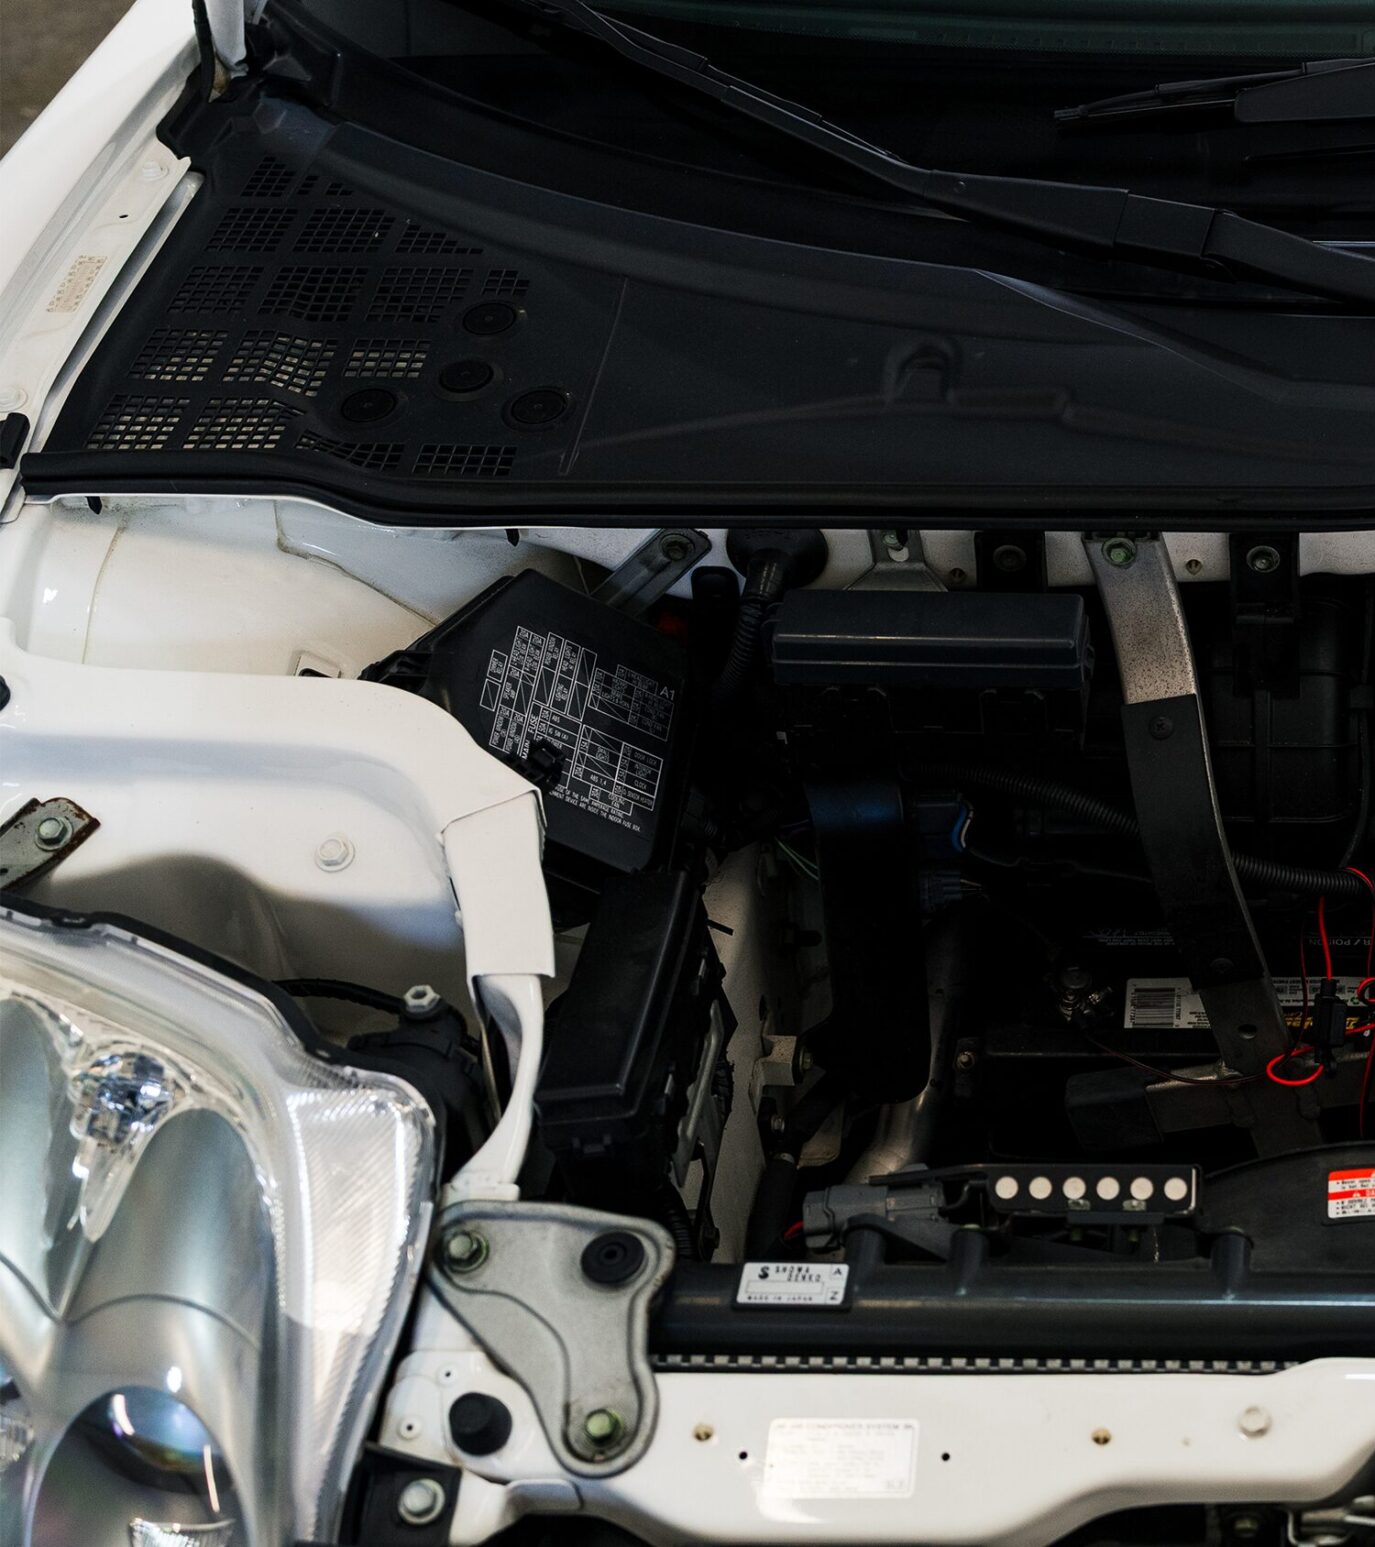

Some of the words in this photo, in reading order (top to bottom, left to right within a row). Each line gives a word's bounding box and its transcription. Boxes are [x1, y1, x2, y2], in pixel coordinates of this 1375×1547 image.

[660, 686, 676, 701] A1
[522, 739, 530, 760] MAIN
[528, 714, 538, 734] FUSE
